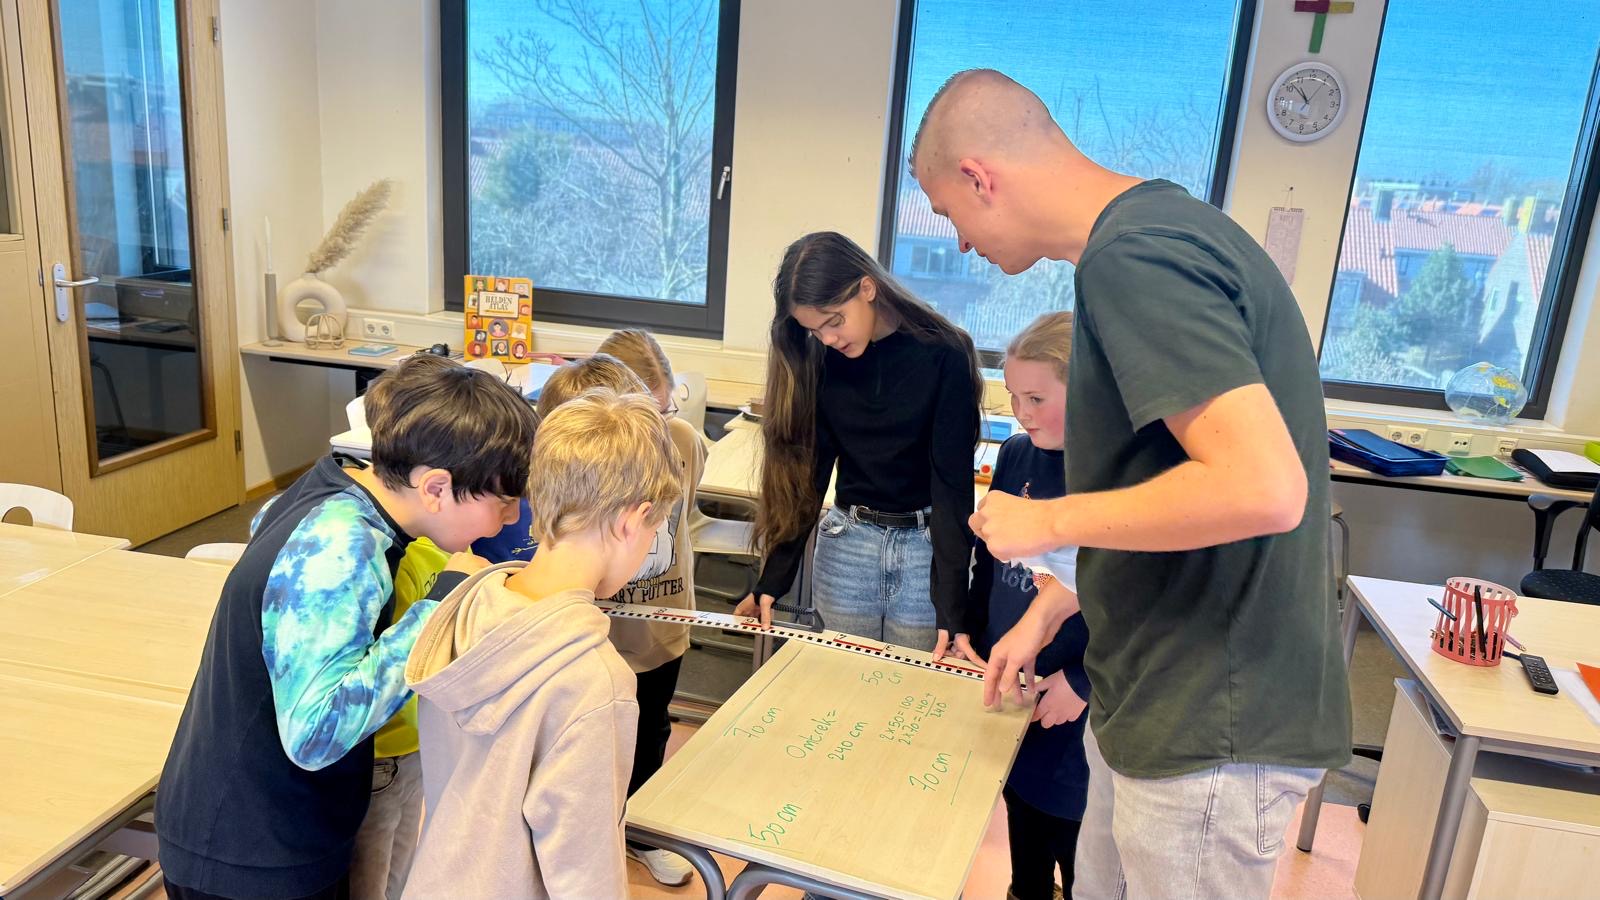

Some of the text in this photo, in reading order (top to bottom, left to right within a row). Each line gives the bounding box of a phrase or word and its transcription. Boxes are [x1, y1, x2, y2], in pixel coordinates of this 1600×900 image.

[1328, 88, 1335, 97] 2
[1329, 101, 1336, 109] 3
[1281, 109, 1287, 117] 8
[641, 576, 684, 603] POTTER
[733, 707, 783, 739] 70 cm
[827, 721, 869, 761] 240 cm
[909, 752, 953, 792] 70 cm
[748, 803, 803, 846] 50 cm
